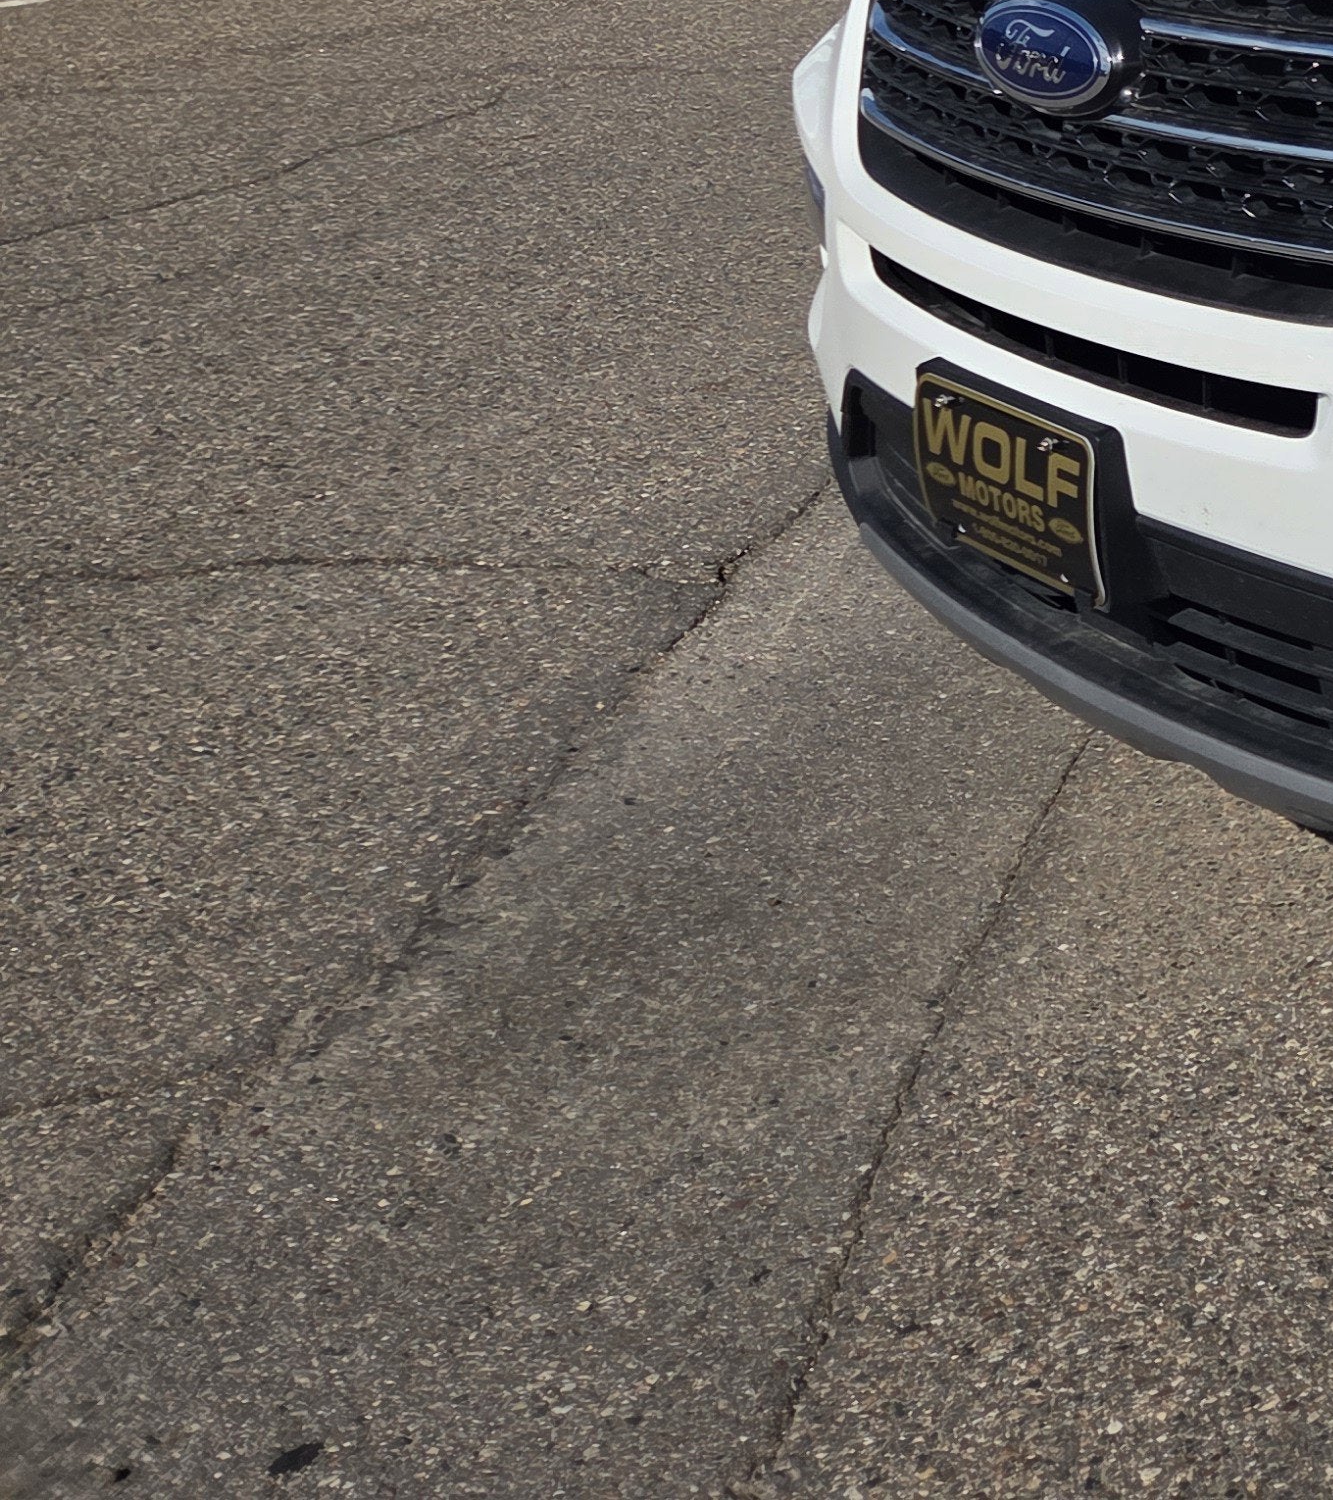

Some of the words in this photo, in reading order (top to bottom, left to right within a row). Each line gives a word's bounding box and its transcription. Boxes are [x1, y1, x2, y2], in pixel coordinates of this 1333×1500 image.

[995, 18, 1071, 85] Ford
[922, 396, 1082, 509] WOLF
[958, 470, 1046, 533] MOTORS
